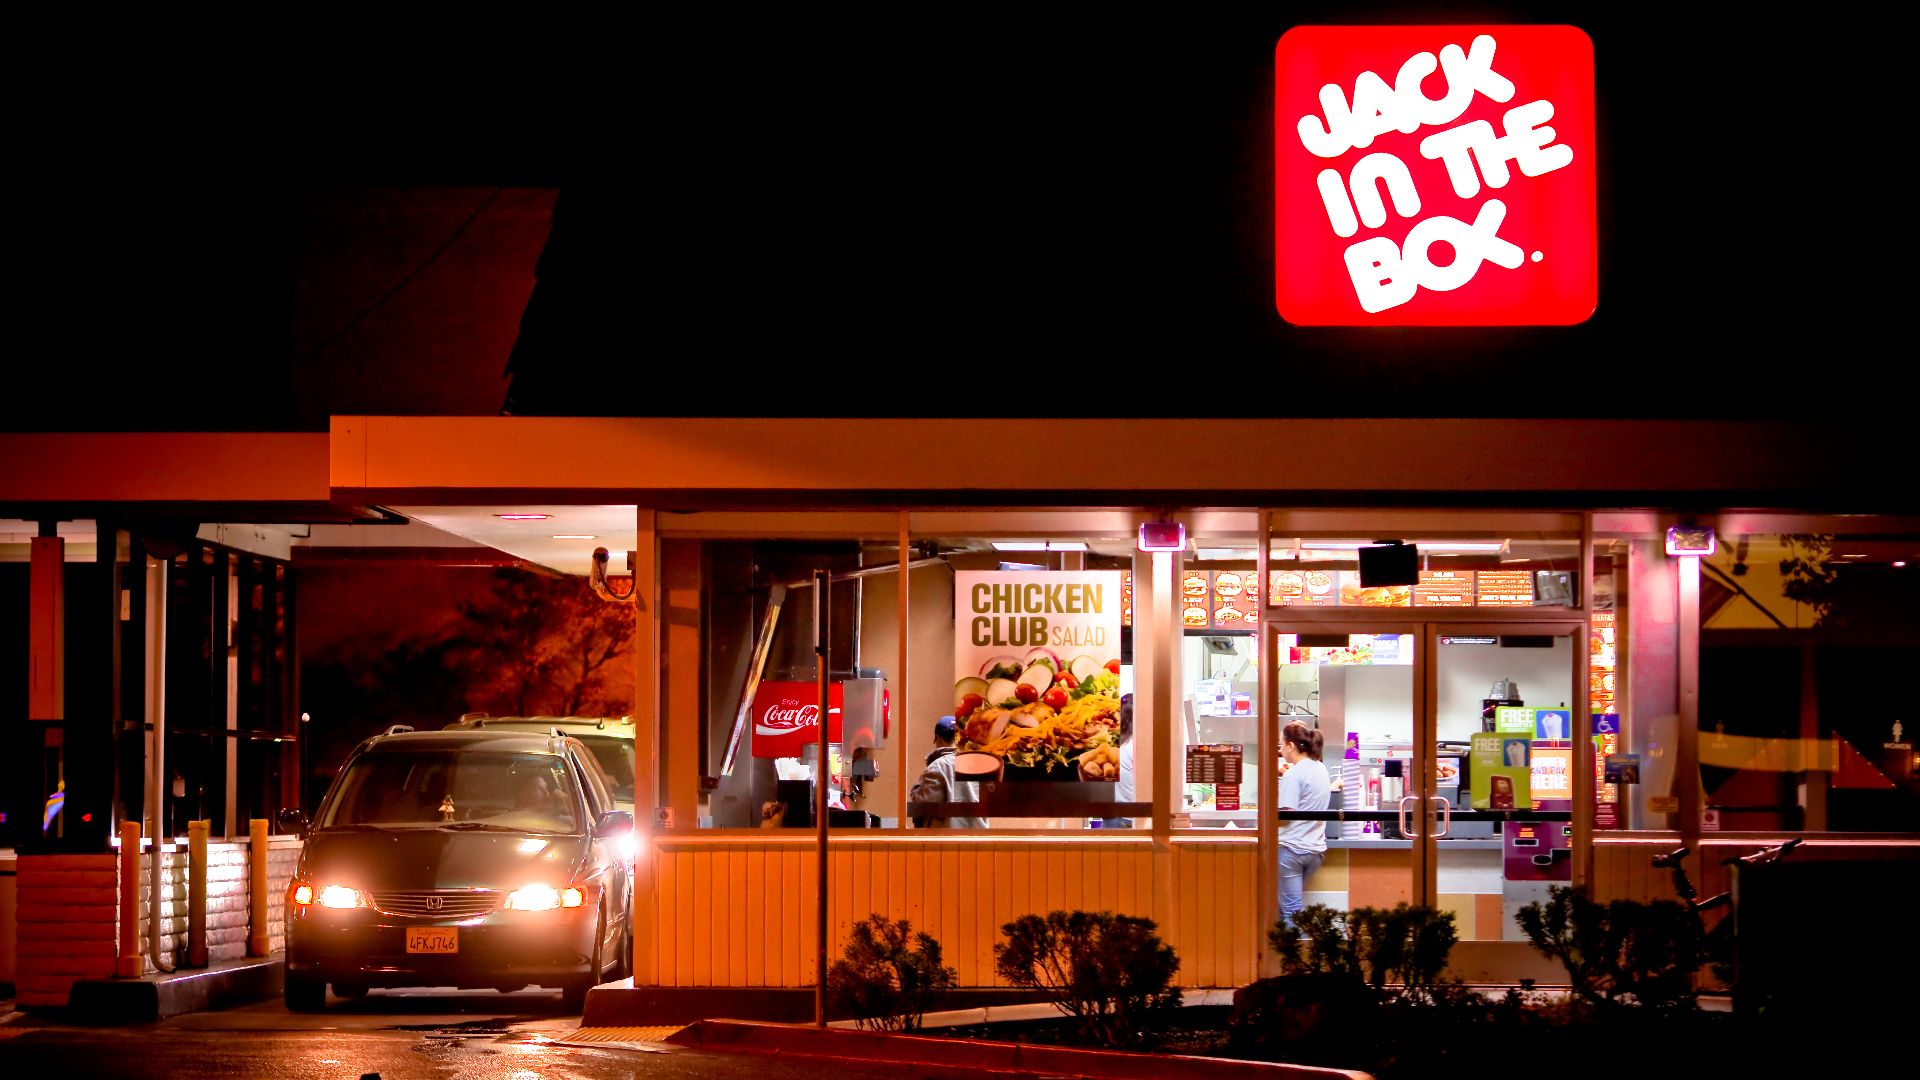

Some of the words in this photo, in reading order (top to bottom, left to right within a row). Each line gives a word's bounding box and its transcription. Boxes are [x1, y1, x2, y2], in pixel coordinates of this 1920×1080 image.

[1297, 34, 1515, 158] JACK
[1420, 99, 1573, 199] THE
[971, 582, 1103, 614] CHICKEN
[971, 616, 1049, 647] CLUB
[1052, 626, 1105, 647] SALAD
[781, 698, 800, 706] Enjoy
[763, 704, 819, 727] Coca-Col
[1501, 709, 1534, 723] FREE
[1475, 738, 1500, 752] FREE
[1883, 742, 1912, 750] WOMEN
[409, 936, 455, 951] 4FKJ746
